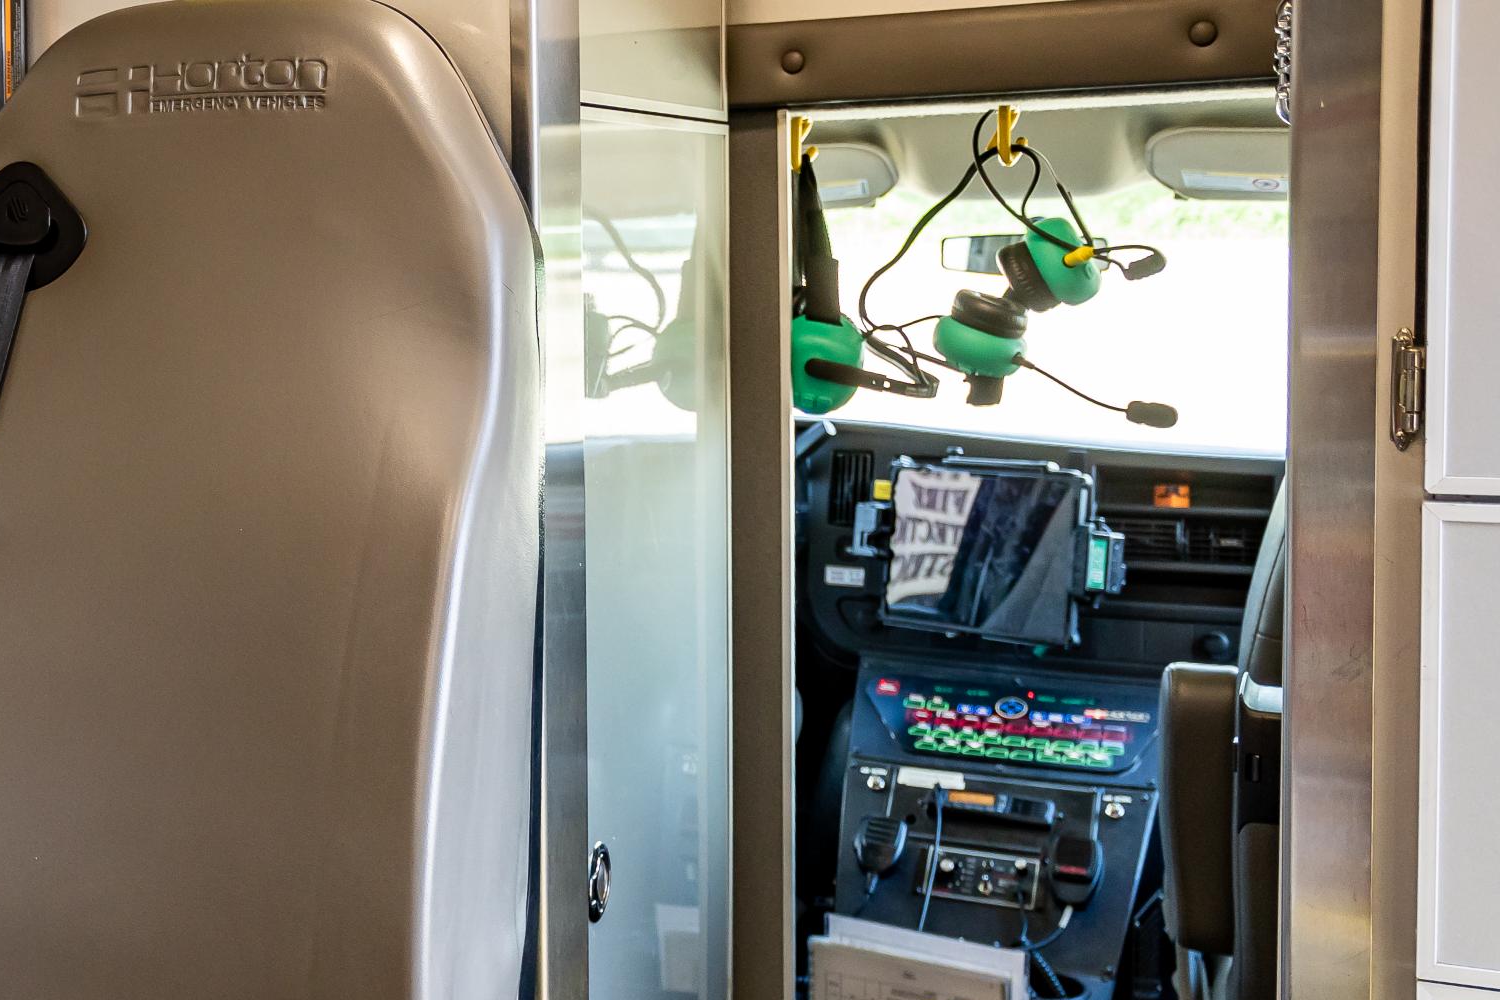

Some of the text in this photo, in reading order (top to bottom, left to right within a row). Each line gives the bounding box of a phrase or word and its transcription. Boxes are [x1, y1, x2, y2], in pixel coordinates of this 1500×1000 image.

[150, 53, 328, 92] Horton
[150, 94, 326, 114] EMERGENCY VEHICLES
